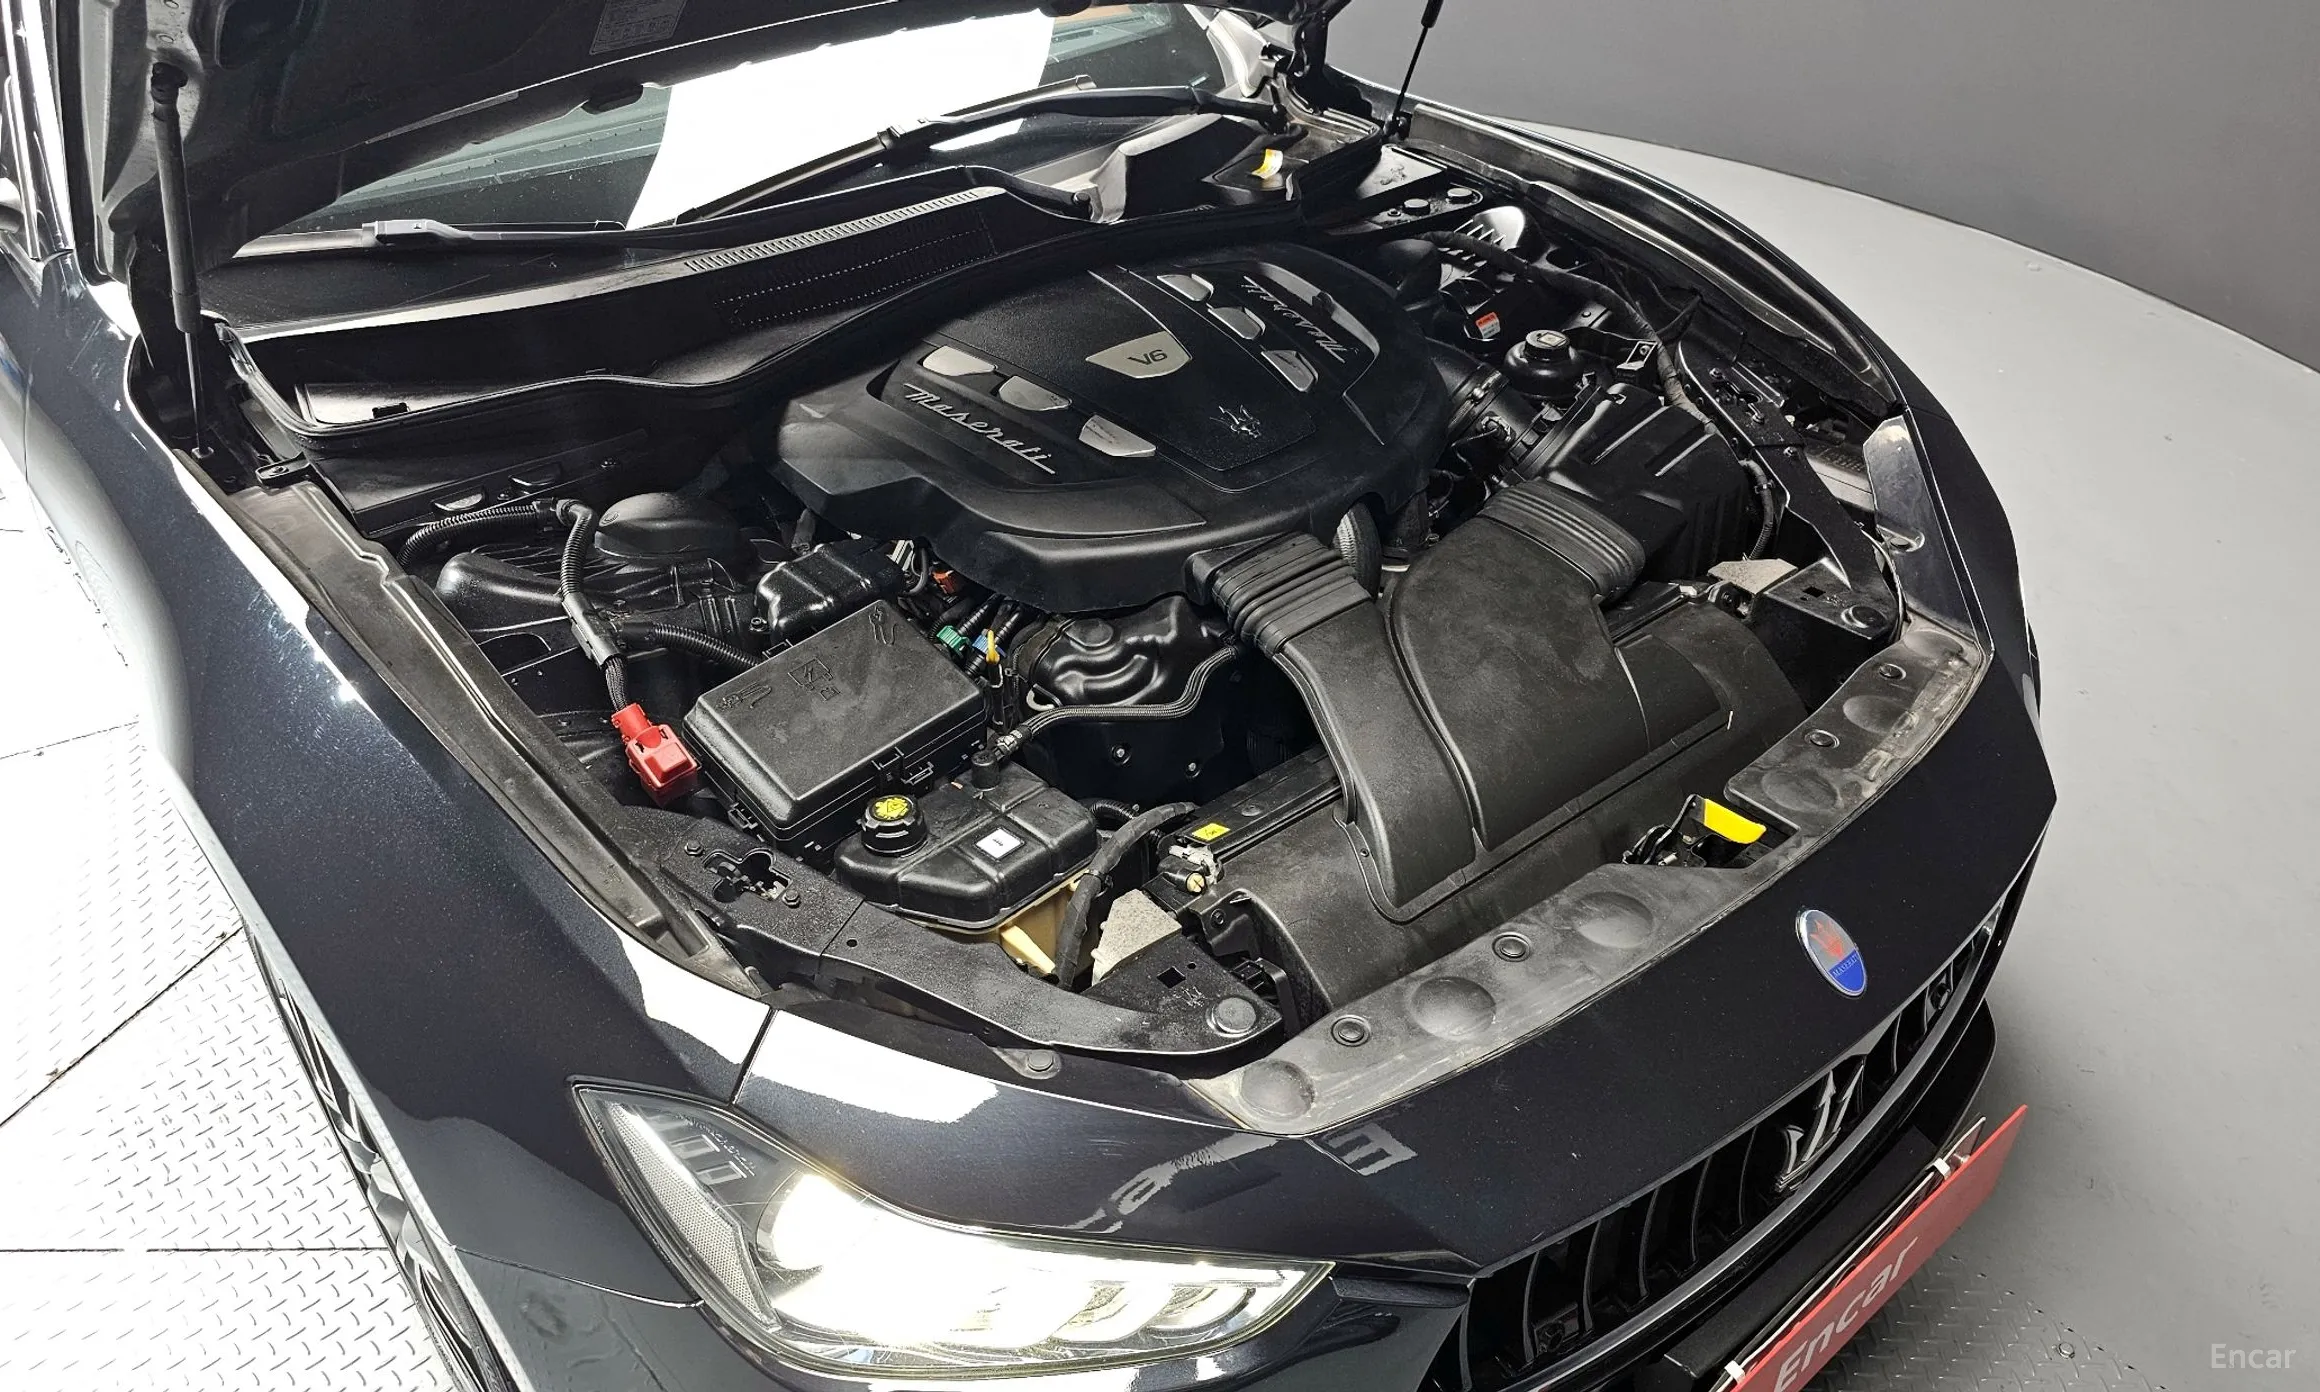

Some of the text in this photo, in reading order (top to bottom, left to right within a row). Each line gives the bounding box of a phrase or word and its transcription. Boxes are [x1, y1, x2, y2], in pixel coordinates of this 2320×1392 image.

[1127, 349, 1168, 366] V6
[903, 383, 1056, 475] Maserati
[1774, 1236, 1918, 1392] Encar
